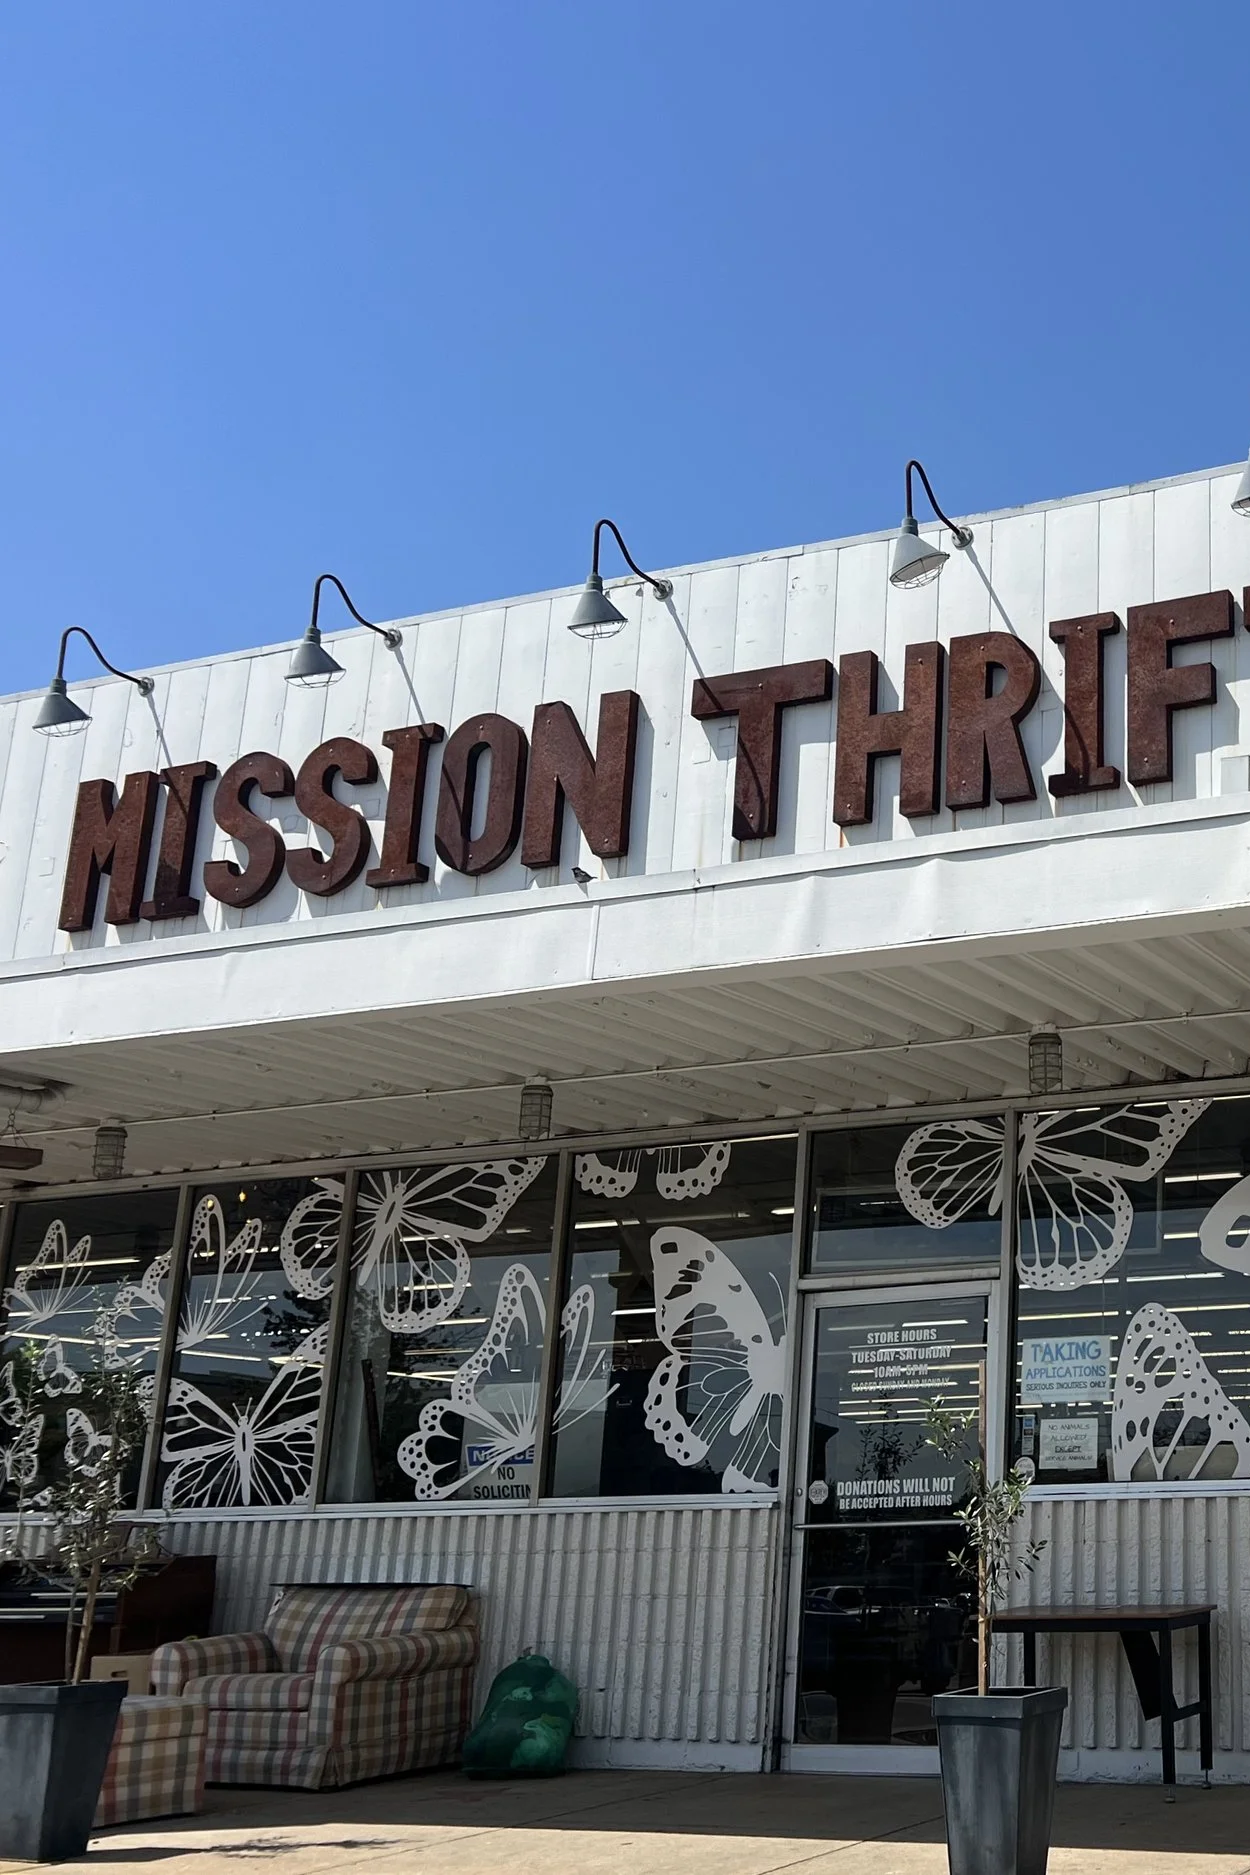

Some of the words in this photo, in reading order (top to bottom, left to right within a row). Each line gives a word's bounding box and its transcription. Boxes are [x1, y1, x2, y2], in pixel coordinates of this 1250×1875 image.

[58, 689, 641, 932] MISSION
[867, 1331, 900, 1345] STORE
[901, 1328, 938, 1342] HOURS
[851, 1346, 952, 1364] TUESDAY-SATURDAY
[1030, 1340, 1102, 1363] TAKING
[1025, 1365, 1107, 1380] APPLICATIONS
[879, 1380, 905, 1391] SUNDAY
[906, 1379, 920, 1390] AND
[921, 1377, 951, 1389] MONDAY
[1026, 1382, 1055, 1392] SERIOUS
[1089, 1380, 1107, 1389] ONLY
[1055, 1445, 1082, 1453] EXCEPT
[497, 1466, 516, 1481] NO
[473, 1483, 532, 1500] SOLICITIN
[836, 1478, 901, 1497] DONATIONS
[902, 1477, 930, 1494] WILL
[932, 1476, 956, 1493] NOT
[839, 1497, 850, 1510] BE
[851, 1495, 894, 1510] ACCEPTED
[895, 1494, 921, 1508] AFTER
[922, 1494, 953, 1508] HOURS
